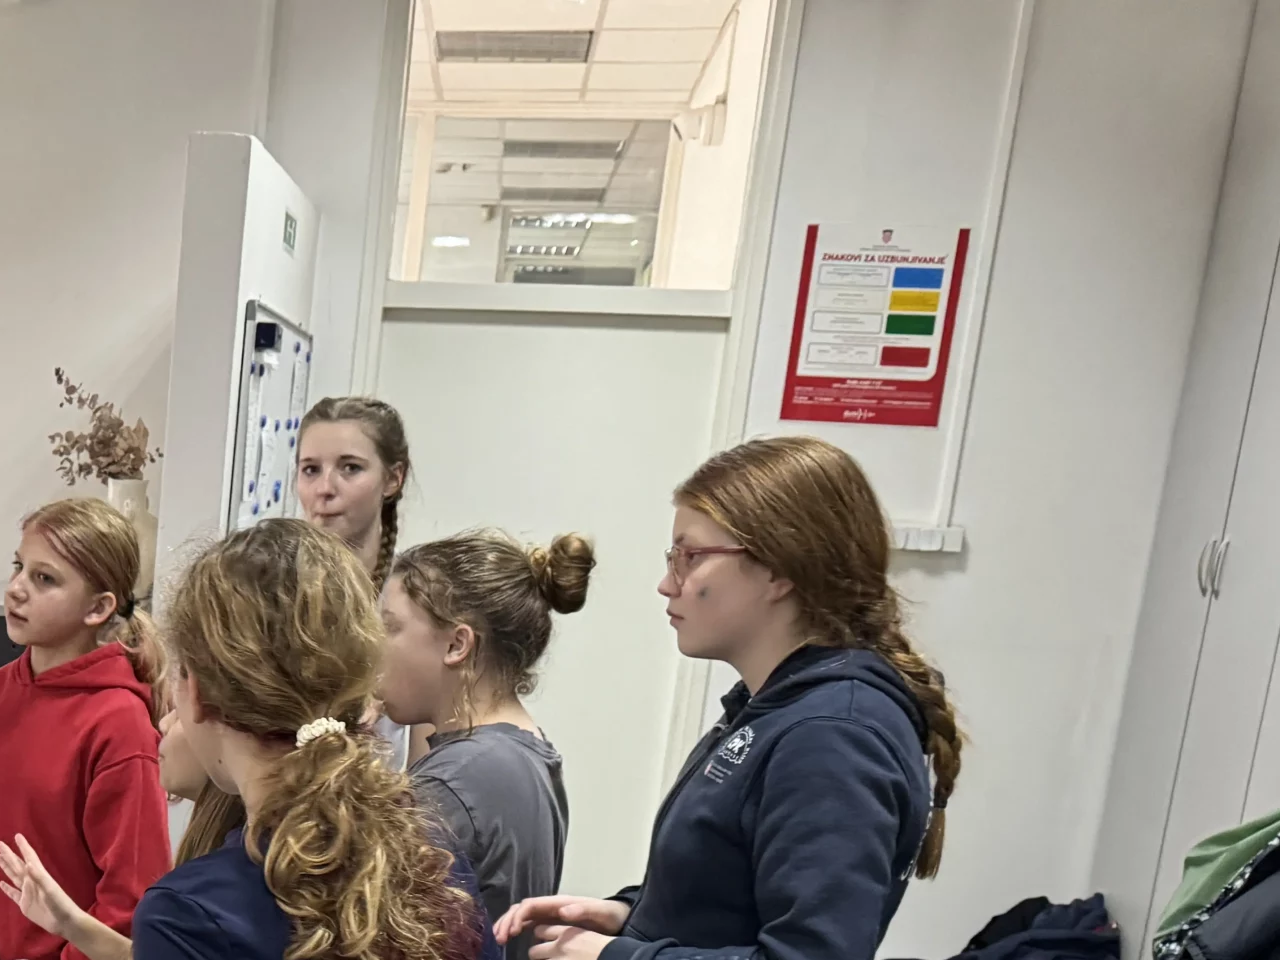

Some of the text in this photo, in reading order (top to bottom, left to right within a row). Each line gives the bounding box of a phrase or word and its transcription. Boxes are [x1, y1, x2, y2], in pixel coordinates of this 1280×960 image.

[822, 252, 946, 264] ZNAKOVI ZA UZBUNJIVANJE
